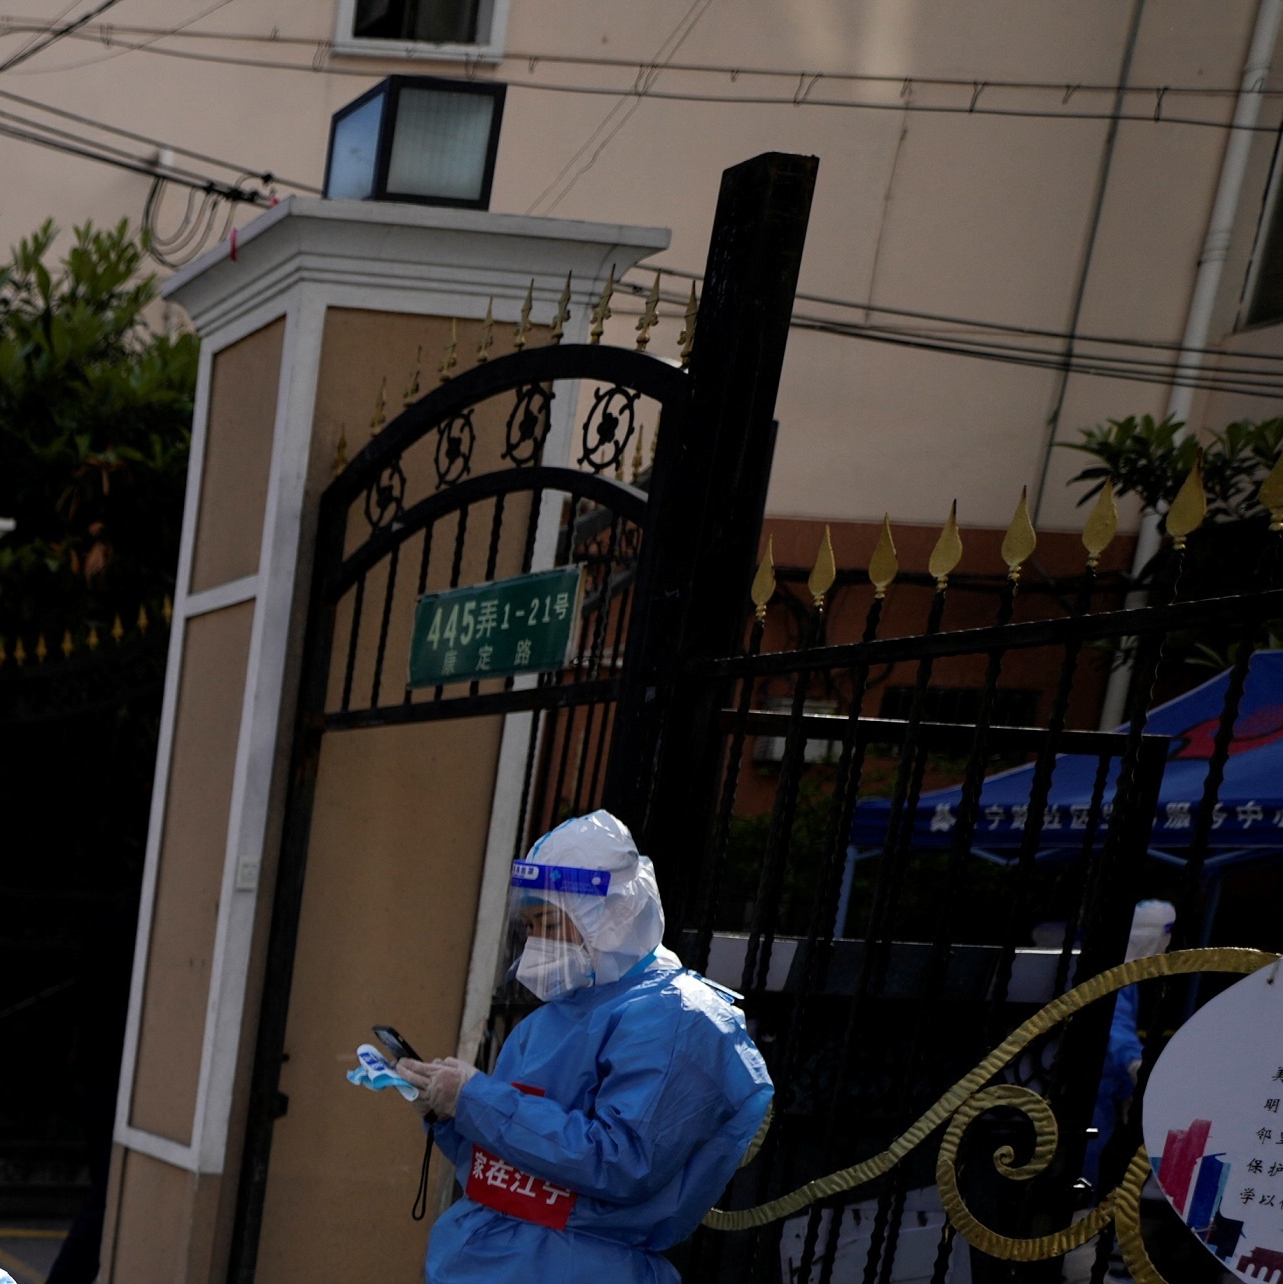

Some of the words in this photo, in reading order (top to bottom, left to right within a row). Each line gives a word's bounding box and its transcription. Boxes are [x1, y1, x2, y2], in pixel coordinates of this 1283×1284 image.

[426, 592, 570, 651] 445弄1-21号
[441, 638, 533, 676] 康定路
